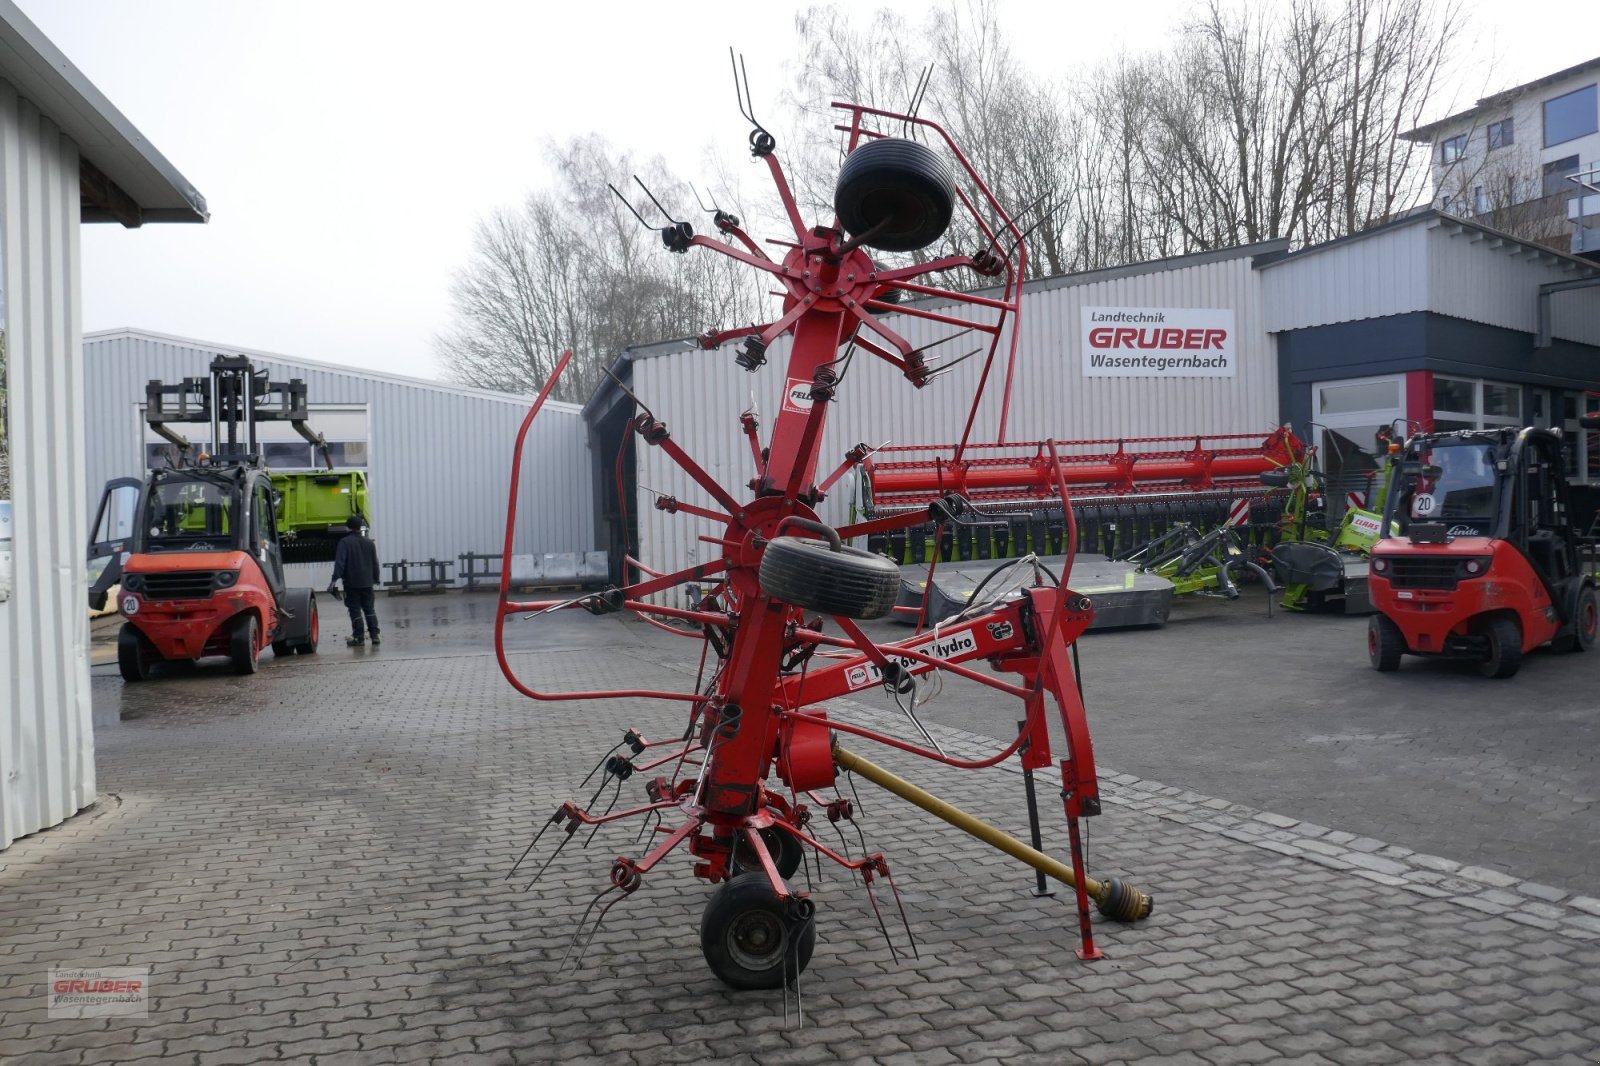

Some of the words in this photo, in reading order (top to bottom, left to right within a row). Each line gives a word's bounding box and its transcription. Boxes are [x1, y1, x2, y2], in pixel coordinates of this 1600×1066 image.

[1091, 312, 1165, 323] Landtechnik
[1089, 327, 1227, 350] GRUBER
[1091, 355, 1227, 371] Wasentegernbach
[1418, 497, 1431, 511] 20
[1355, 518, 1379, 531] CLAAS
[1446, 525, 1479, 536] Linde
[126, 599, 136, 611] 20
